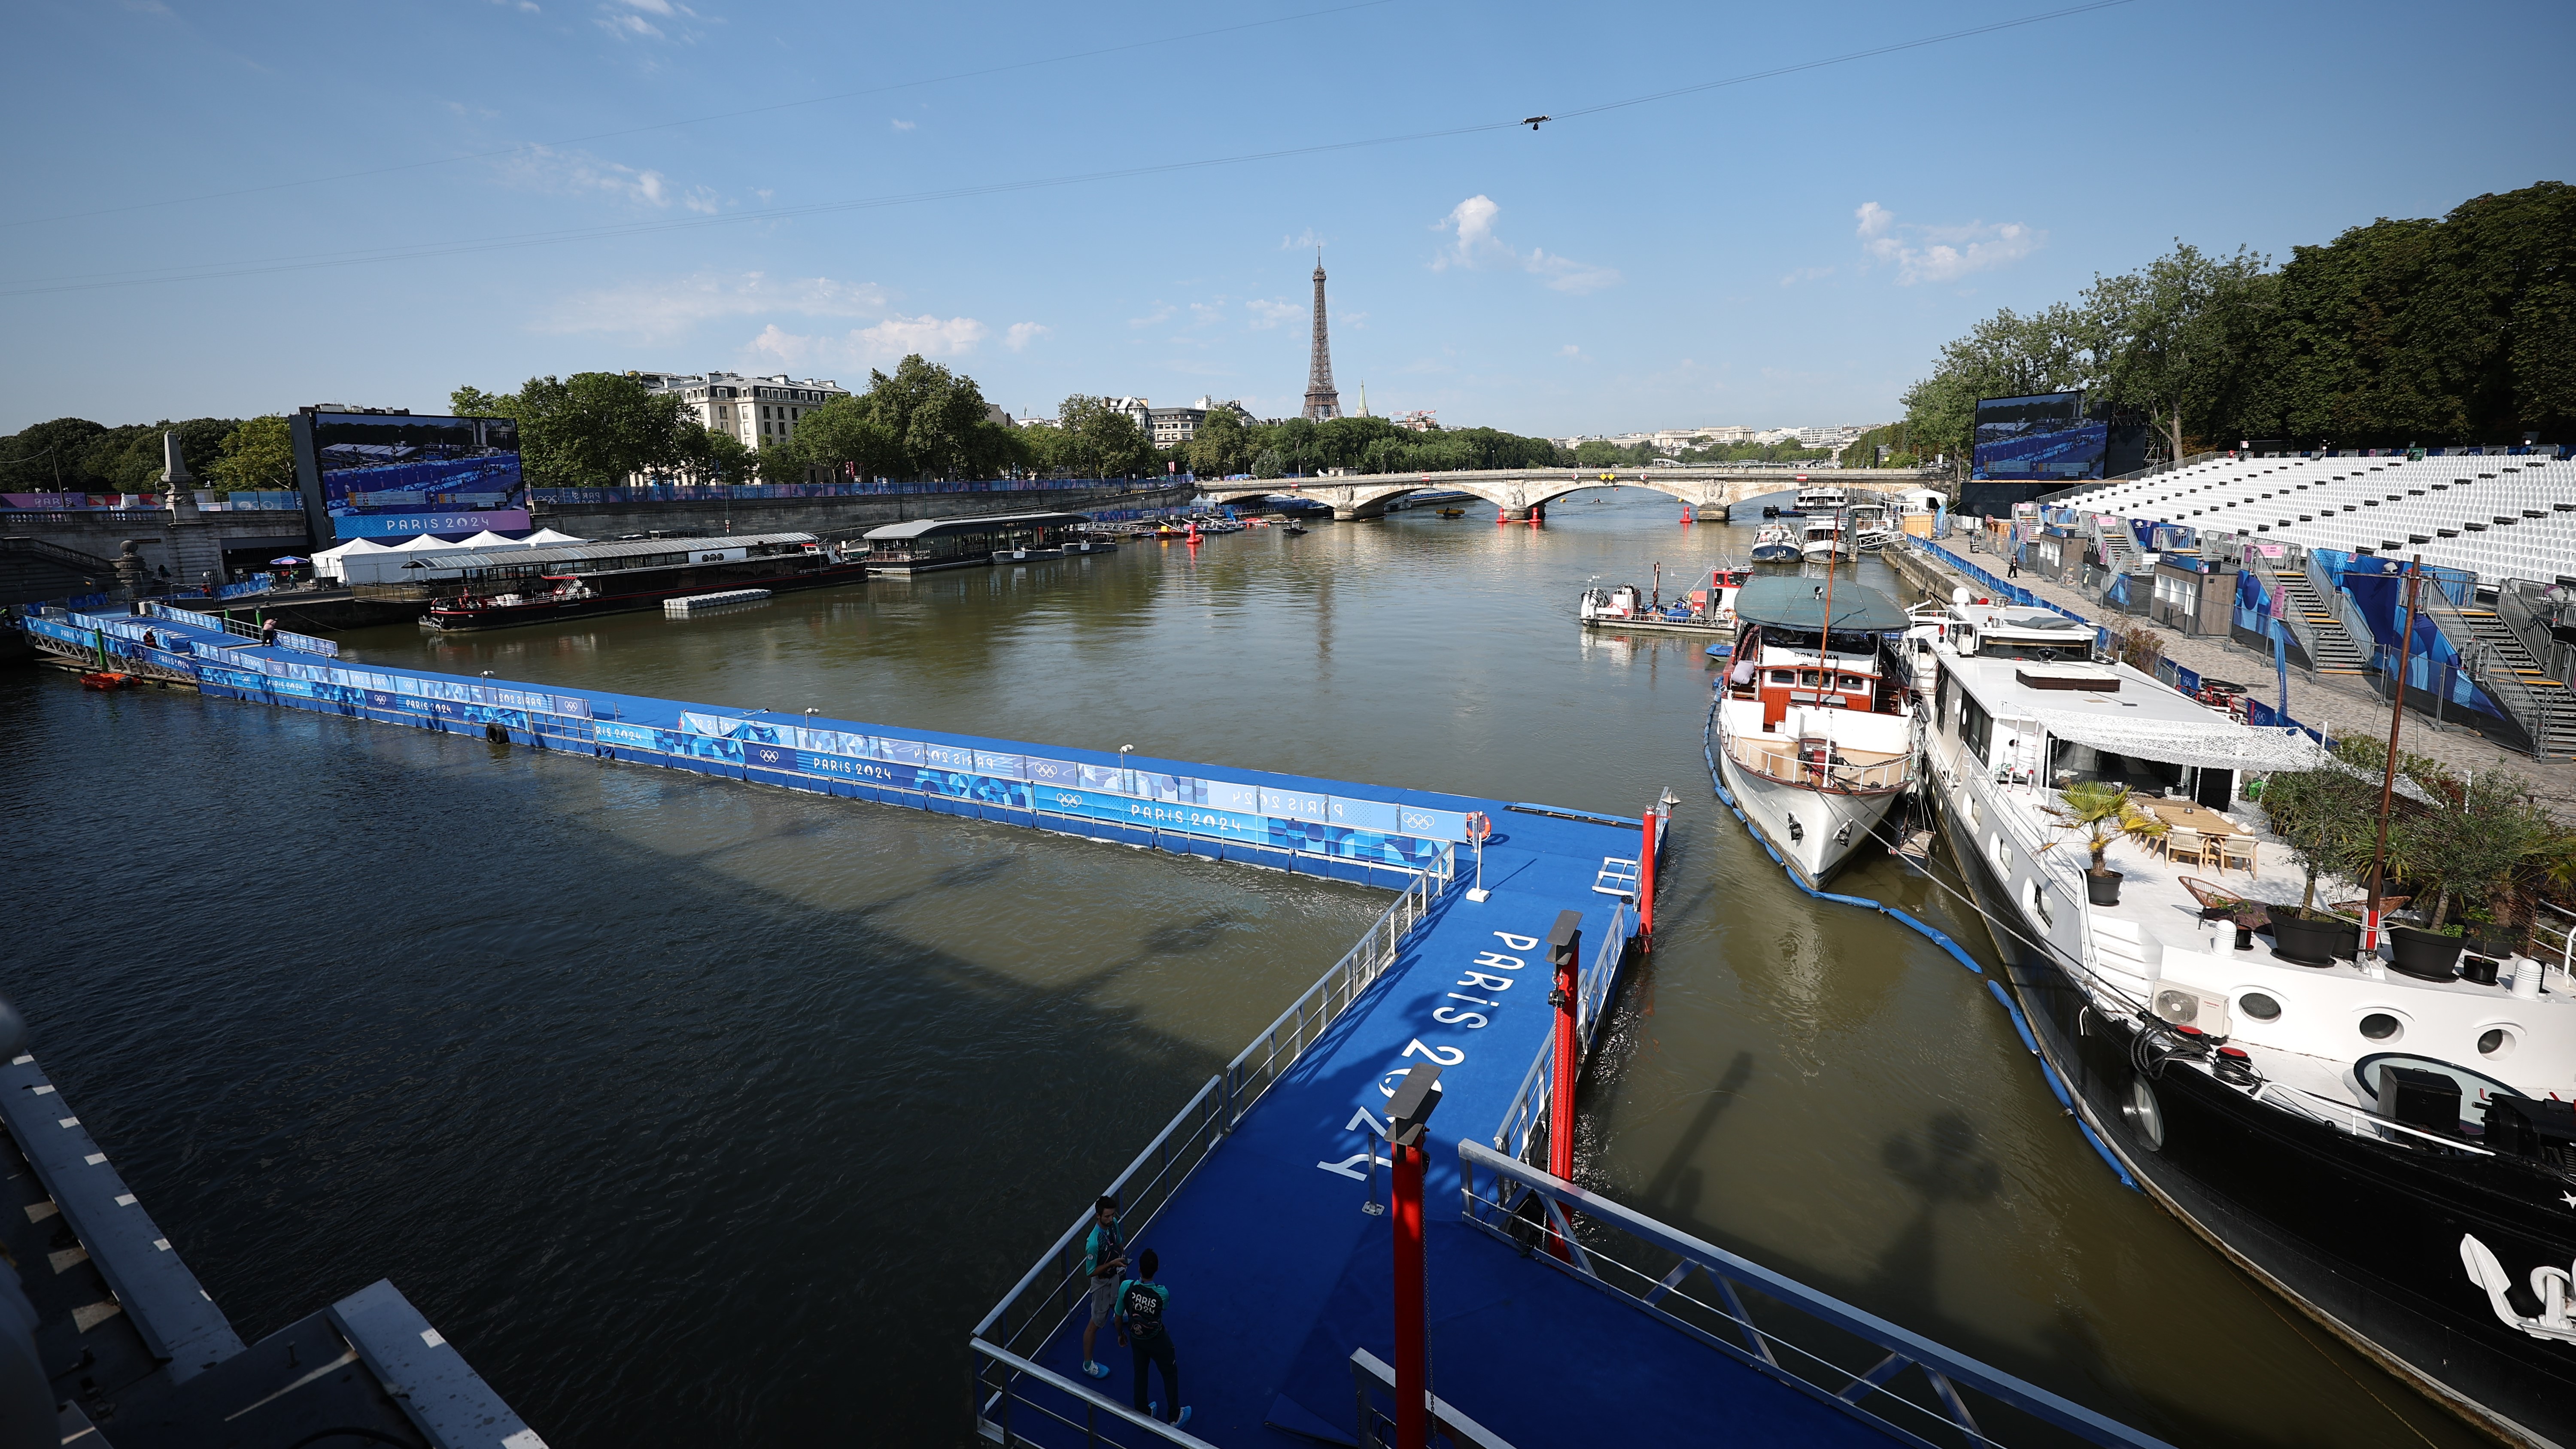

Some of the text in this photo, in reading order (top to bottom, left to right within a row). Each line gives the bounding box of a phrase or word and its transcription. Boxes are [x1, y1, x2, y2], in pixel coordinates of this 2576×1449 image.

[387, 517, 489, 530] PARIS 2024
[406, 699, 452, 714] PARIS 2024
[596, 726, 642, 741] RIS 2024
[814, 757, 891, 780] PARIS 2024
[1131, 804, 1241, 832] PARIS 2024
[1433, 931, 1539, 1029] PARIS
